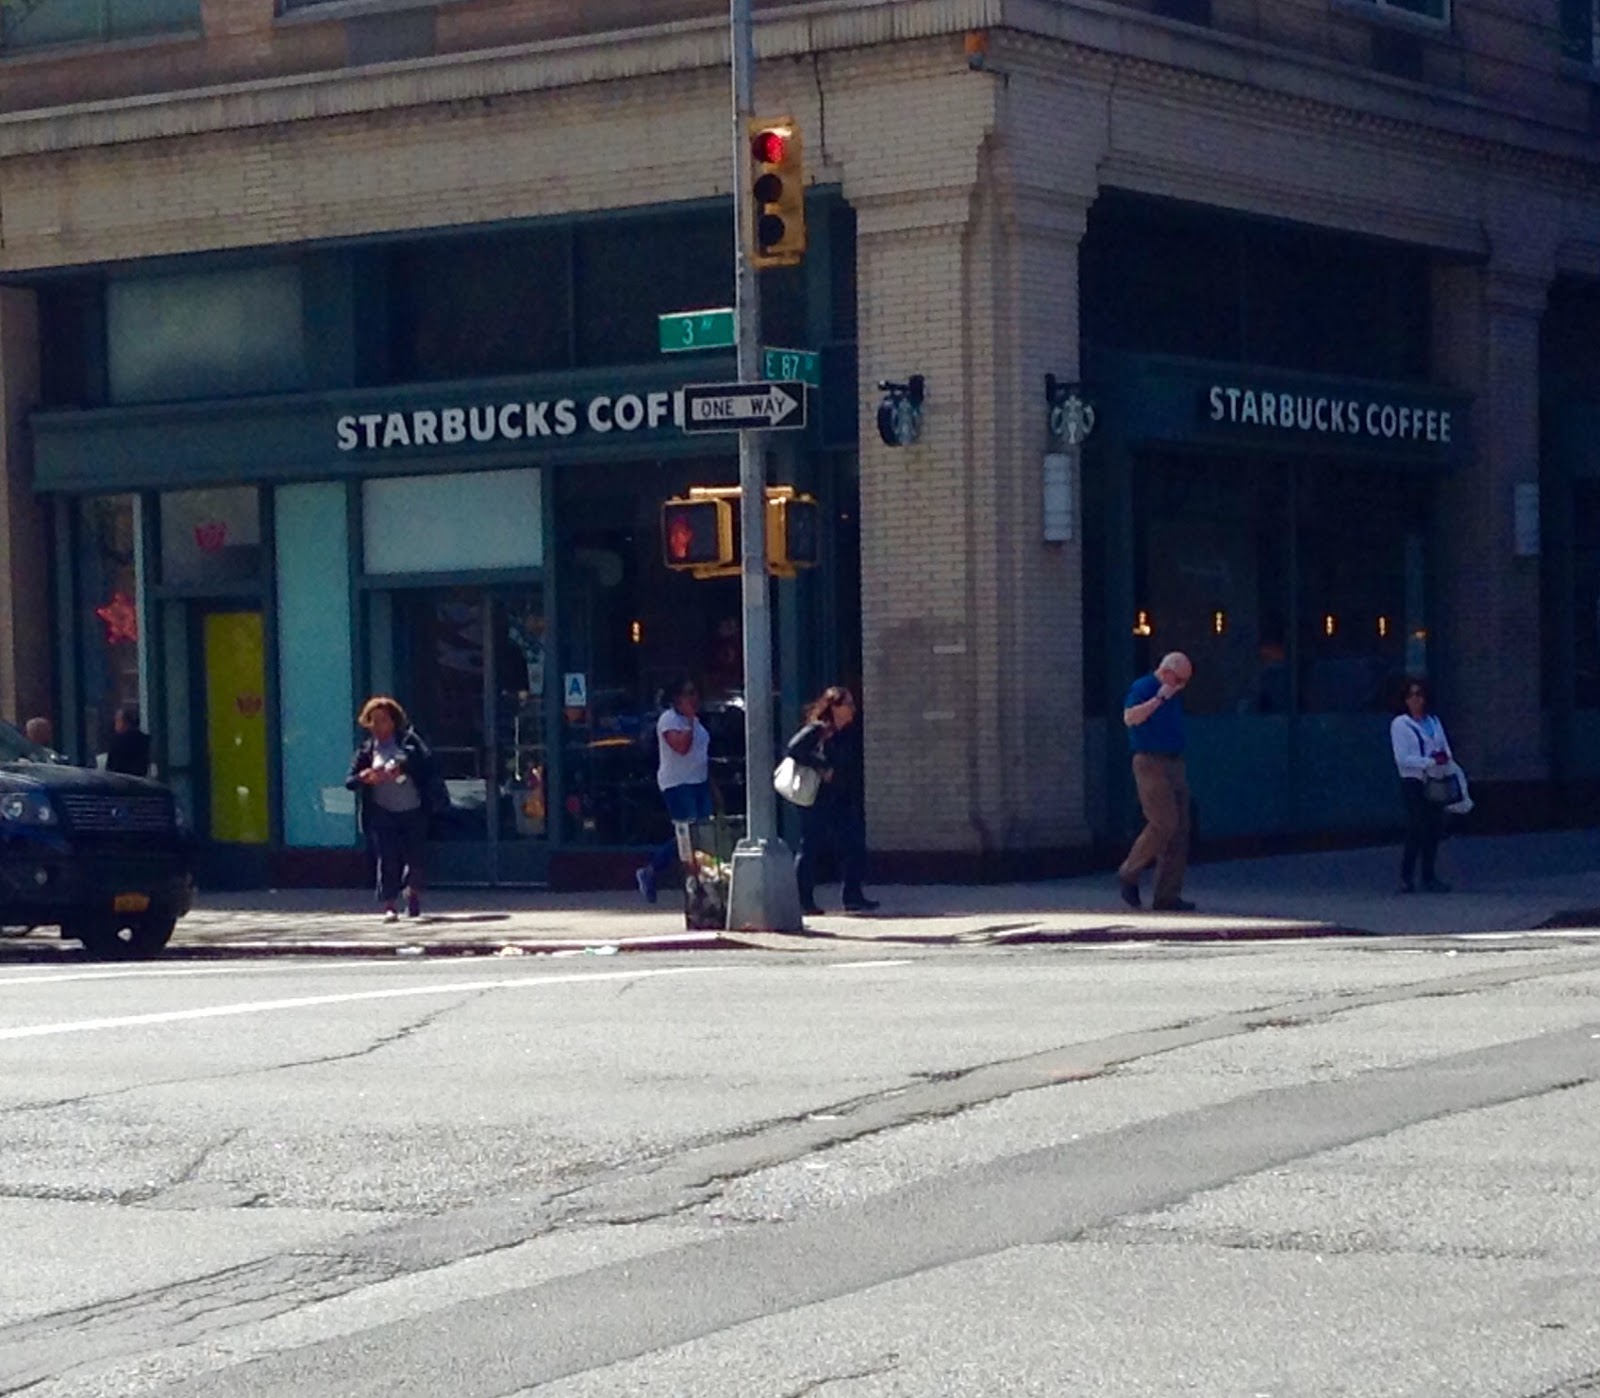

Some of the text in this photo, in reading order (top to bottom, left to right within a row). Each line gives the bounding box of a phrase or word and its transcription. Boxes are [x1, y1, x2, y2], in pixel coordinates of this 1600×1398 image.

[682, 319, 693, 345] 3
[766, 352, 775, 378] E
[782, 354, 799, 381] 87
[701, 396, 786, 418] ONE WAY
[1210, 386, 1451, 442] STARBUCKS COFFEE
[336, 398, 577, 451] STARBUCKS
[568, 677, 583, 696] A
